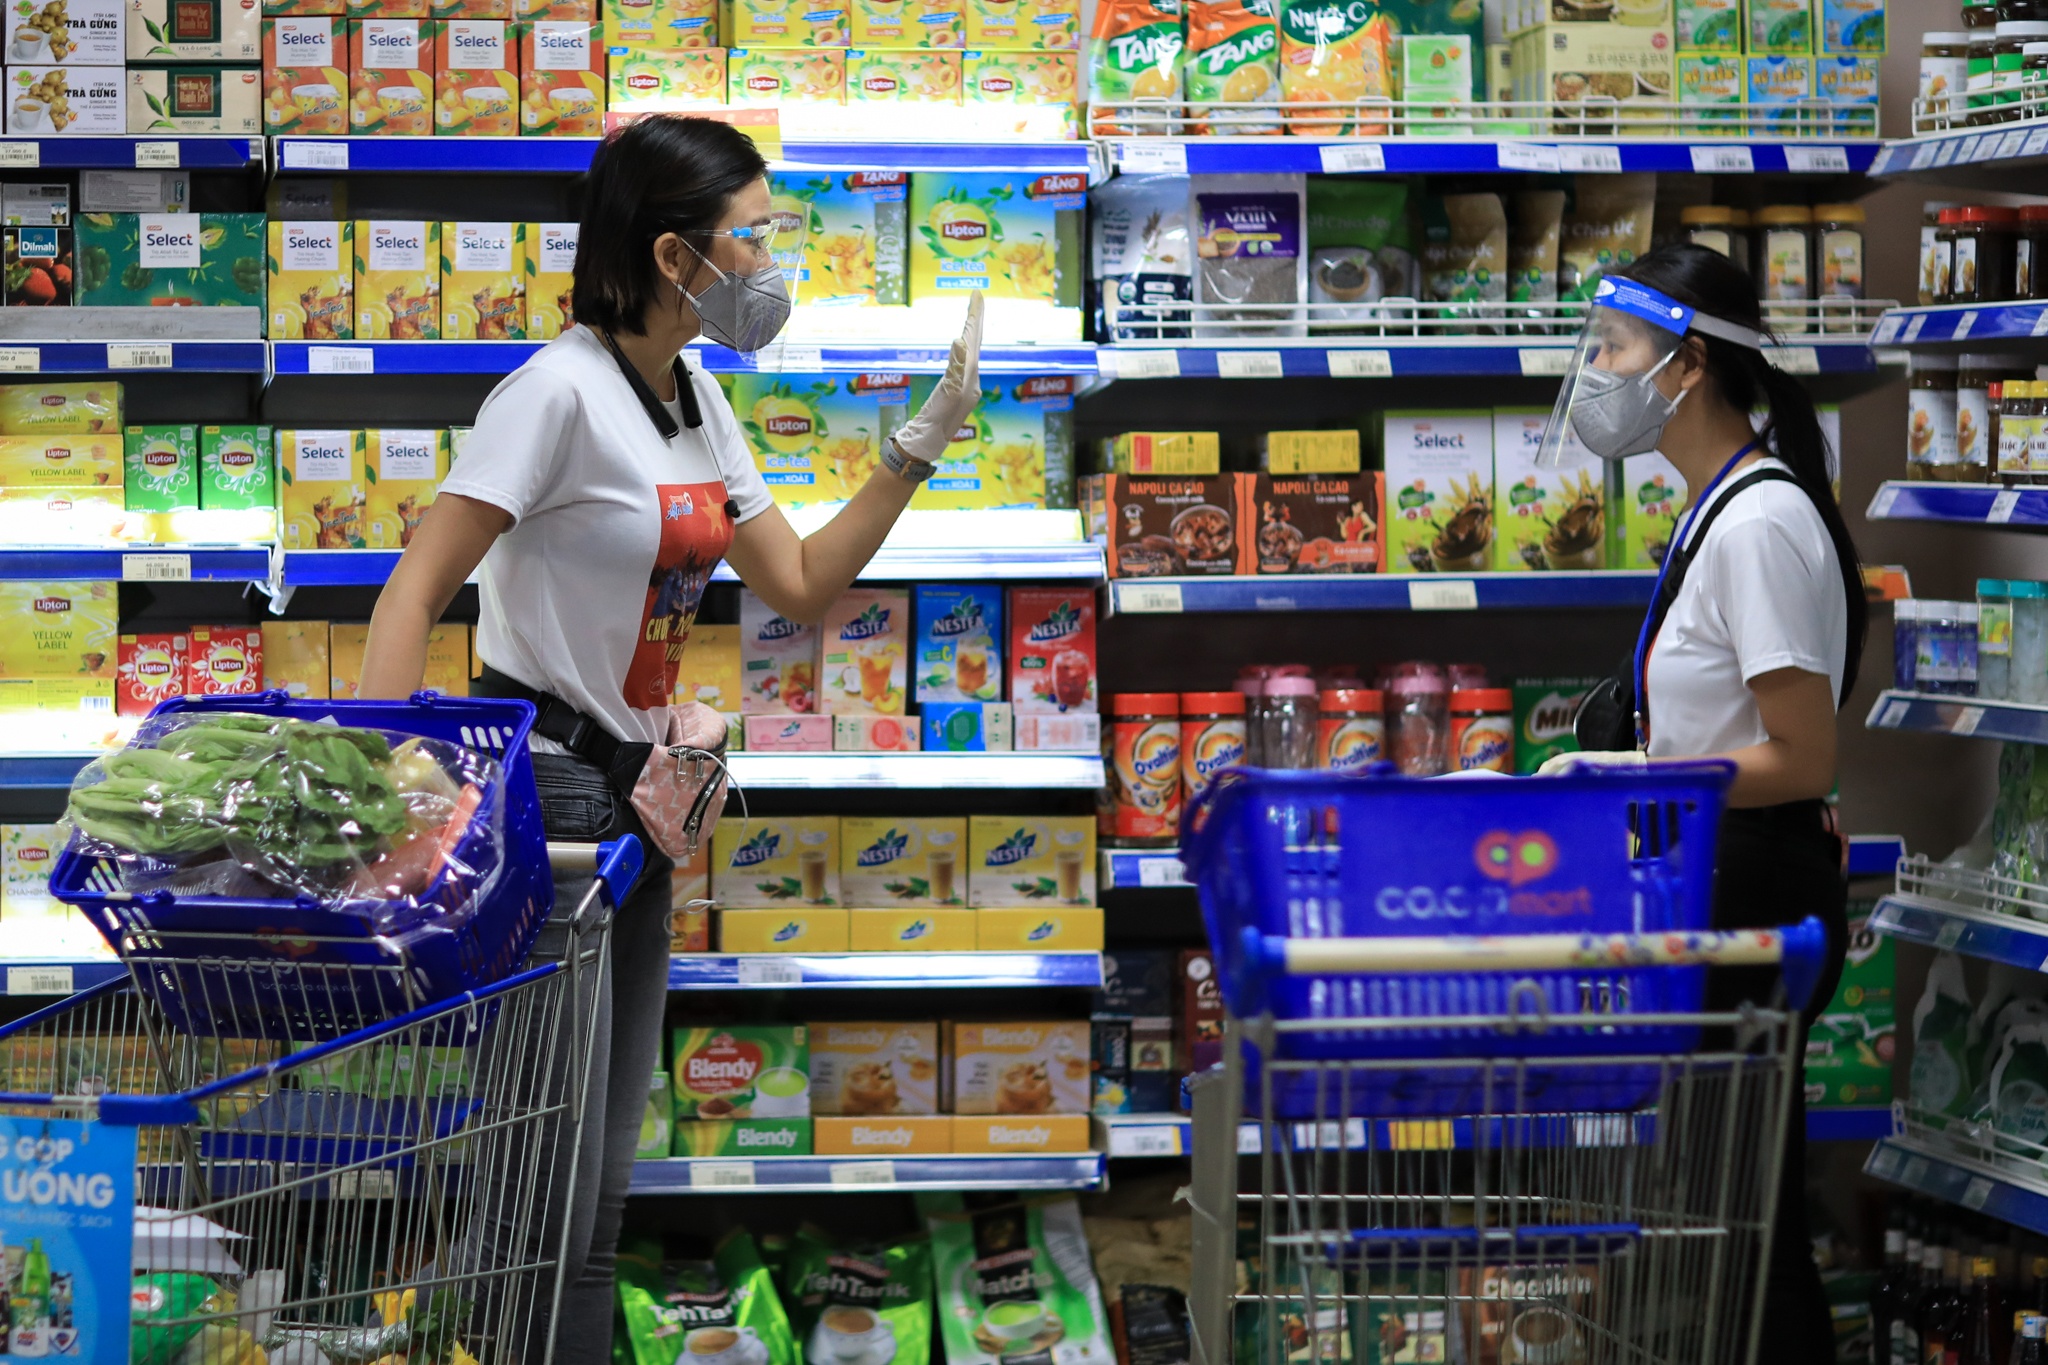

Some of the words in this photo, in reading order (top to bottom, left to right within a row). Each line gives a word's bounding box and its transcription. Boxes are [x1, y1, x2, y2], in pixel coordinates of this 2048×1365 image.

[65, 18, 86, 29] TRÀ
[283, 33, 325, 45] Select
[369, 35, 412, 47] Select
[455, 35, 497, 48] Select
[541, 36, 583, 49] Select
[1200, 30, 1275, 73] TANG
[630, 78, 658, 87] Lipton
[750, 79, 777, 88] Lipton
[866, 81, 894, 89] Lipton
[983, 81, 1012, 89] Lipton
[65, 87, 86, 97] TRÀ
[944, 224, 985, 238] Lipton
[22, 241, 55, 251] Dilmah
[147, 234, 193, 246] Select
[289, 237, 332, 249] Select
[376, 237, 419, 249] Select
[462, 238, 505, 249] Select
[546, 239, 578, 251] Sele
[940, 259, 961, 272] ice
[964, 260, 986, 272] tea
[43, 397, 65, 405] Lipton
[58, 414, 81, 423] LABEL
[769, 419, 808, 432] Lipton
[1414, 434, 1465, 448] Select
[47, 450, 69, 458] Lipton
[302, 447, 344, 458] Select
[387, 446, 429, 458] Select
[148, 454, 175, 465] Lipton
[224, 454, 252, 465] Lipton
[766, 455, 786, 467] ice
[788, 455, 810, 467] tea
[30, 468, 59, 477] YELLOW
[60, 468, 86, 477] LABEL
[954, 462, 976, 474] tea
[1129, 482, 1166, 495] NAPOLI
[1273, 481, 1310, 494] NAPOLI
[37, 601, 68, 612] Lipton
[840, 622, 891, 640] NESTEA
[932, 616, 984, 635] NESTEA
[1031, 622, 1082, 640] NESTEA
[32, 631, 72, 640] YELLOW
[38, 641, 68, 649] LABEL
[140, 664, 169, 673] Lipton
[214, 660, 242, 671] Lipton
[20, 850, 46, 860] Lipton
[732, 846, 780, 866] NESTEA
[858, 846, 908, 866] NESTEA
[986, 846, 1036, 866] NESTEA
[828, 1027, 885, 1047] Blendy
[982, 1027, 1040, 1047] Blendy
[689, 1058, 756, 1080] Blendy
[738, 1128, 797, 1148] Blendy
[852, 1127, 913, 1147] Blendy
[989, 1126, 1051, 1146] Blendy
[650, 1285, 754, 1322] TehTarik
